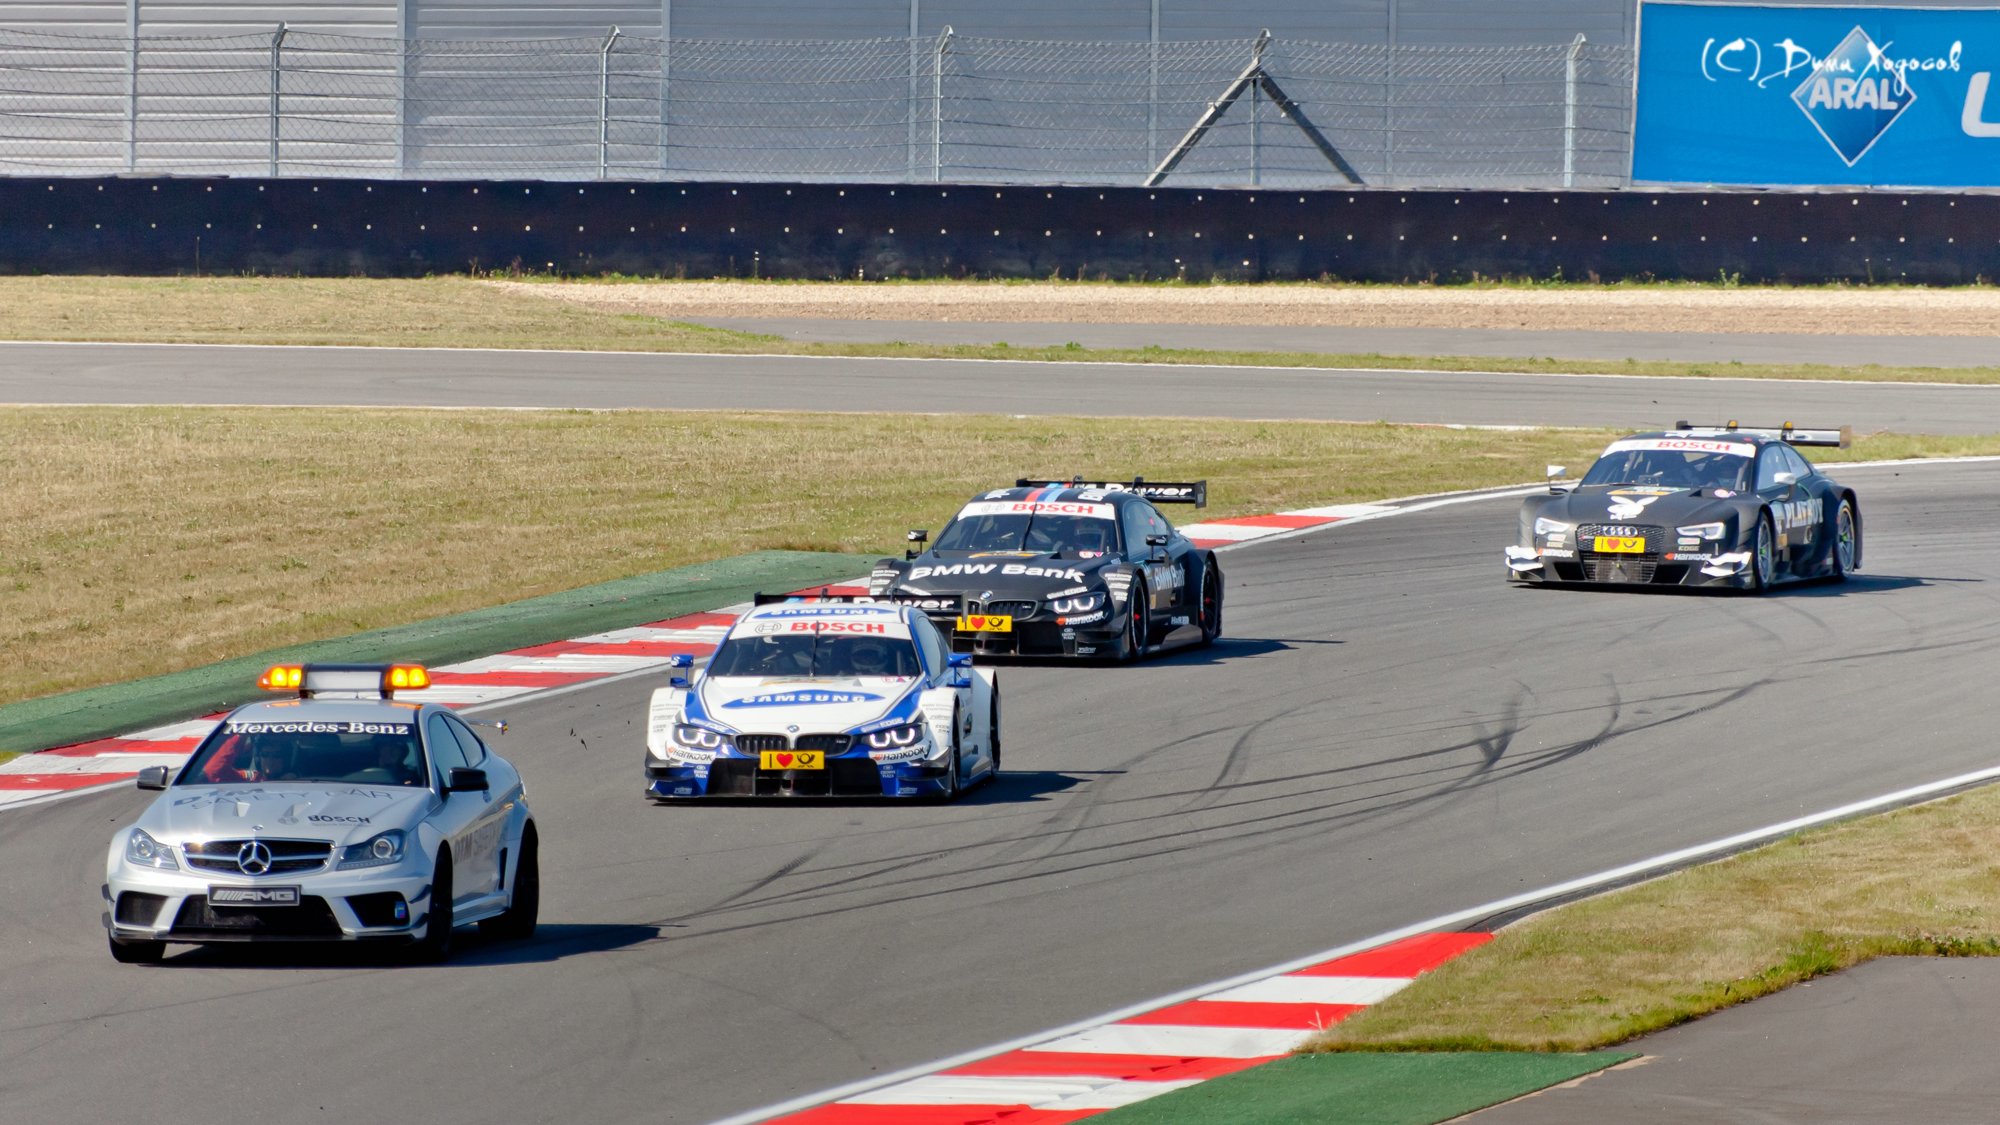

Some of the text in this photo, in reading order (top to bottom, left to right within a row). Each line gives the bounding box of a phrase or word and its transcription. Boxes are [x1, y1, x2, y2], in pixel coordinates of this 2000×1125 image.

[1808, 78, 1898, 110] ARAL
[1656, 441, 1731, 451] BOSCH
[1011, 503, 1094, 514] BOSCH
[909, 563, 998, 581] BMW
[1001, 563, 1086, 583] Bank
[770, 607, 880, 616] SAMSUNG
[790, 621, 886, 634] BOSCH
[741, 693, 867, 704] SAMSUNG
[223, 720, 409, 735] Mercedes-Benz
[308, 815, 372, 825] BOSCH
[240, 890, 295, 902] AMG
